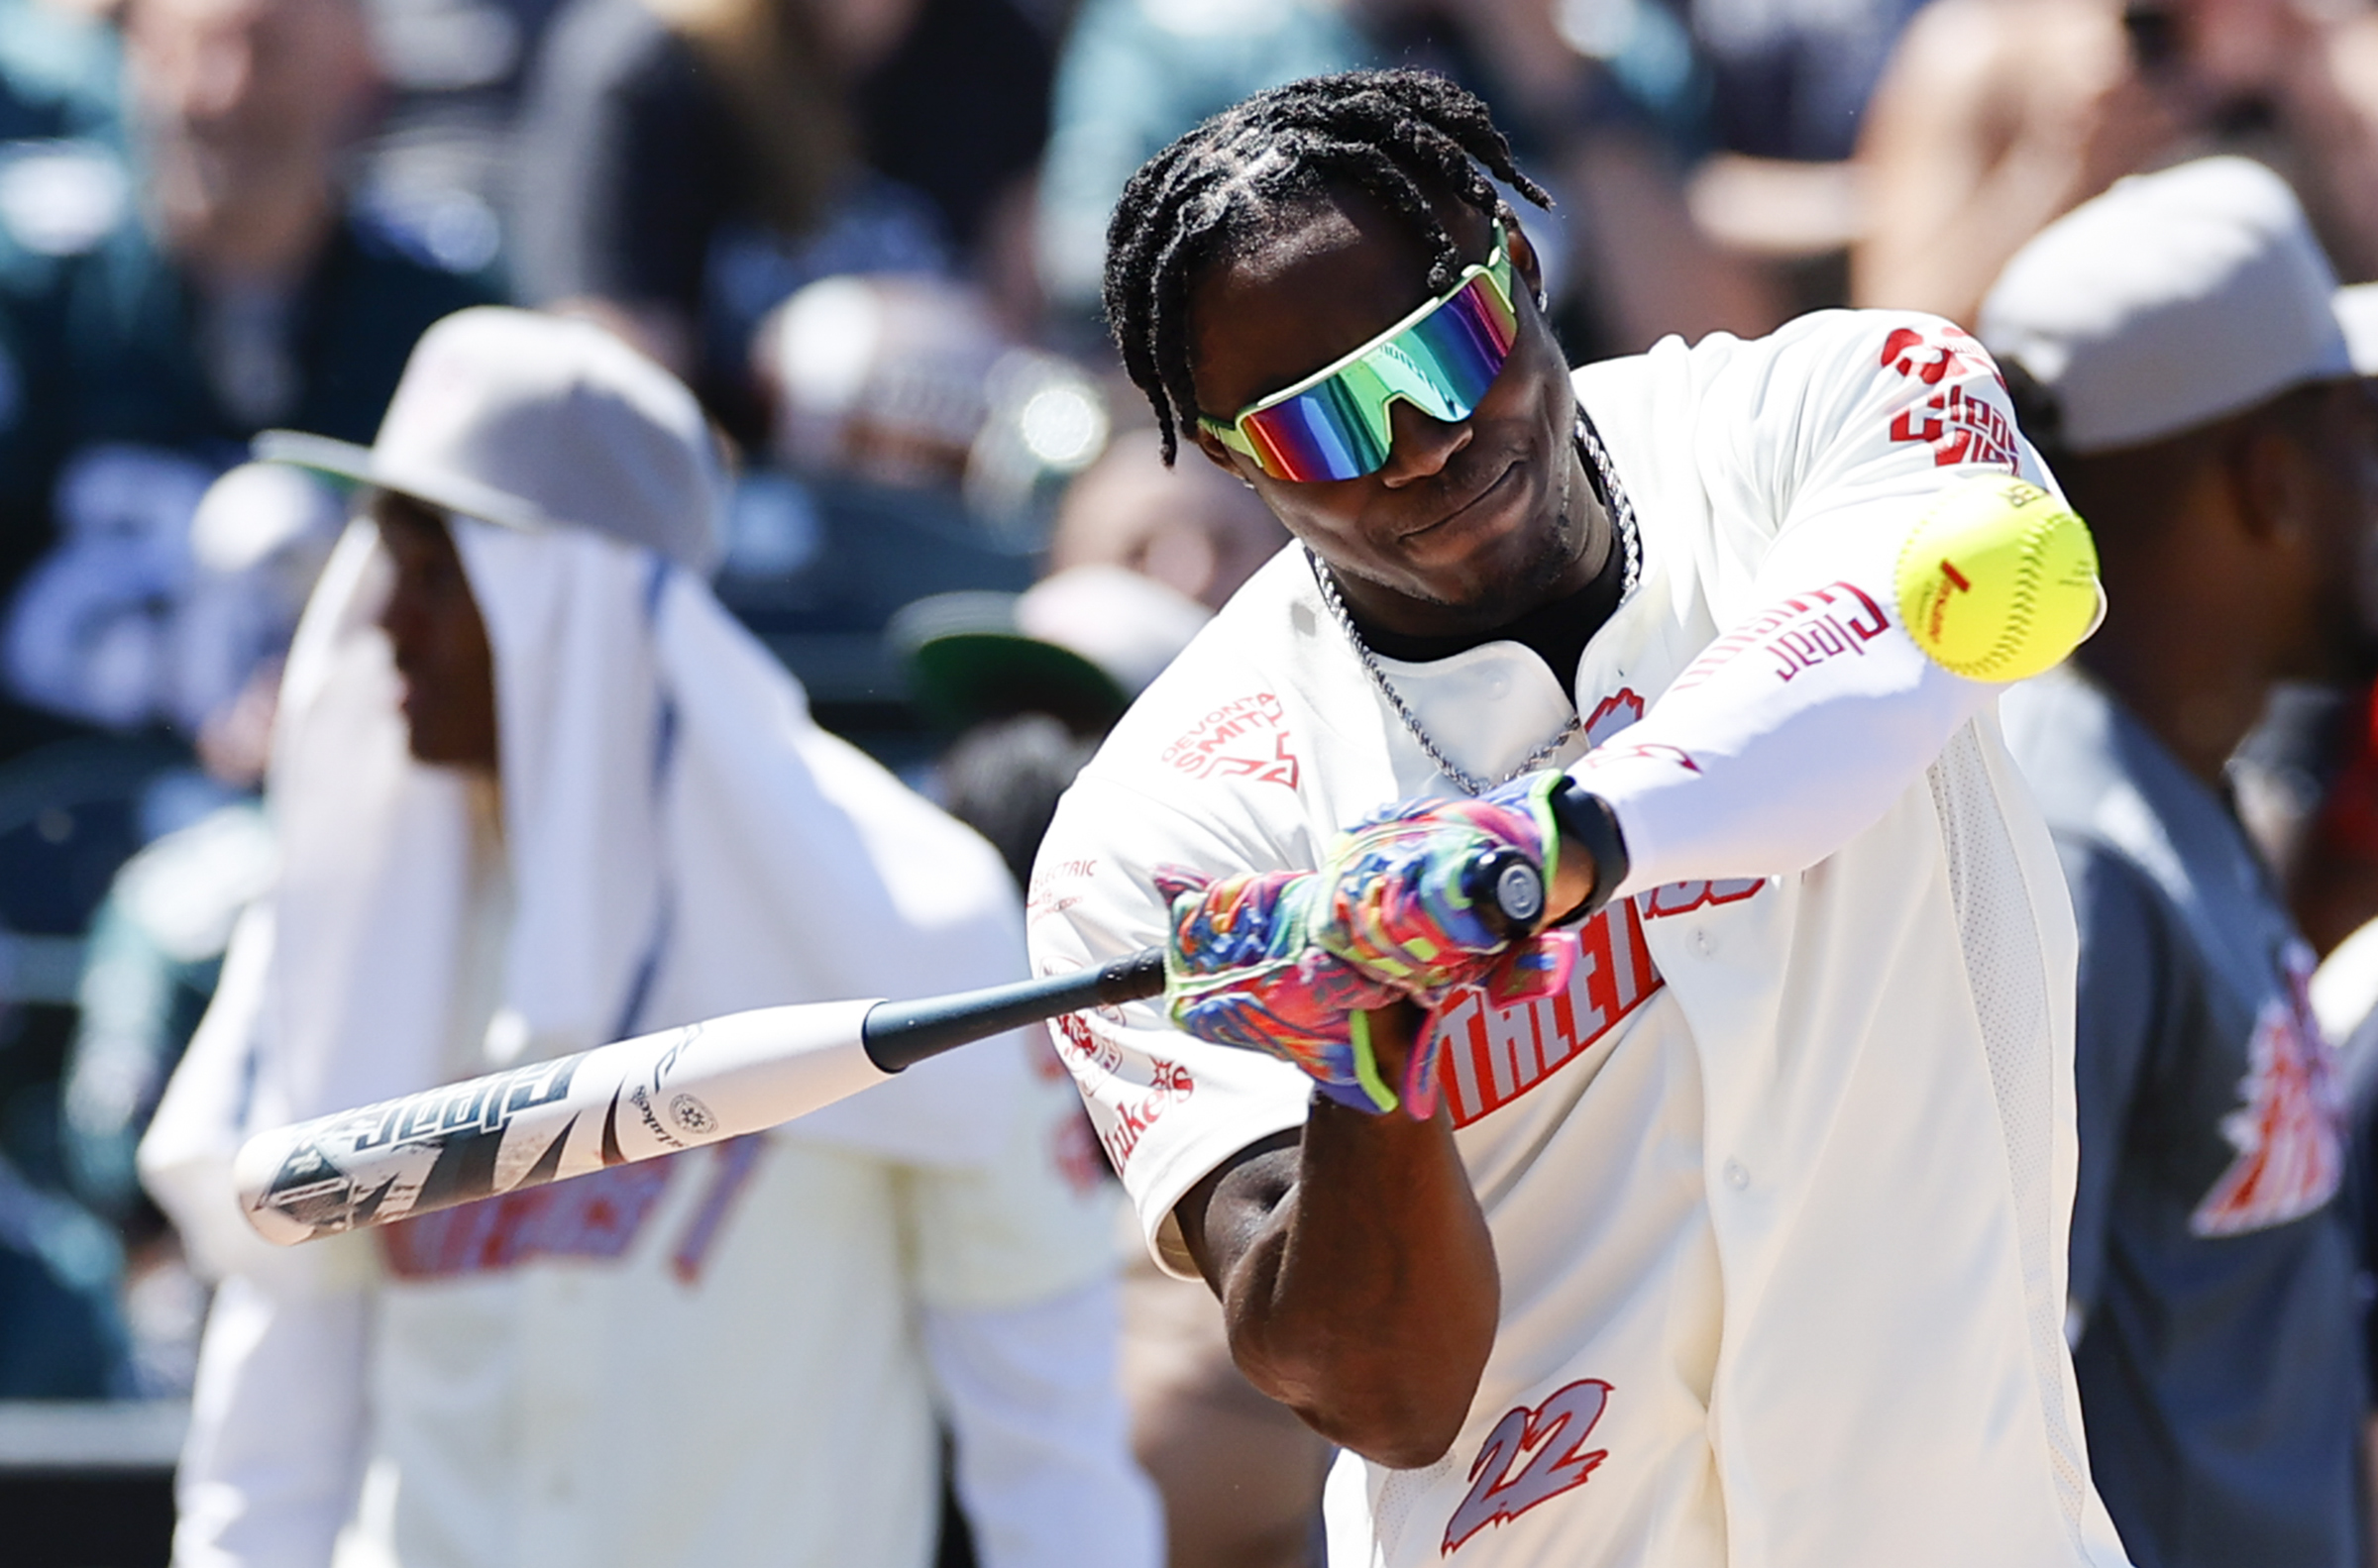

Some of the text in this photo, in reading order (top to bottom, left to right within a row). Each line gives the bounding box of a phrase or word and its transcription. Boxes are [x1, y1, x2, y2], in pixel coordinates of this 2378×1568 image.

[1765, 580, 1892, 682] Clear
[1161, 692, 1276, 763] DEVONTA
[1174, 699, 1283, 774] SMITH
[349, 1052, 589, 1152] Clear
[1441, 1378, 1615, 1560] 22
